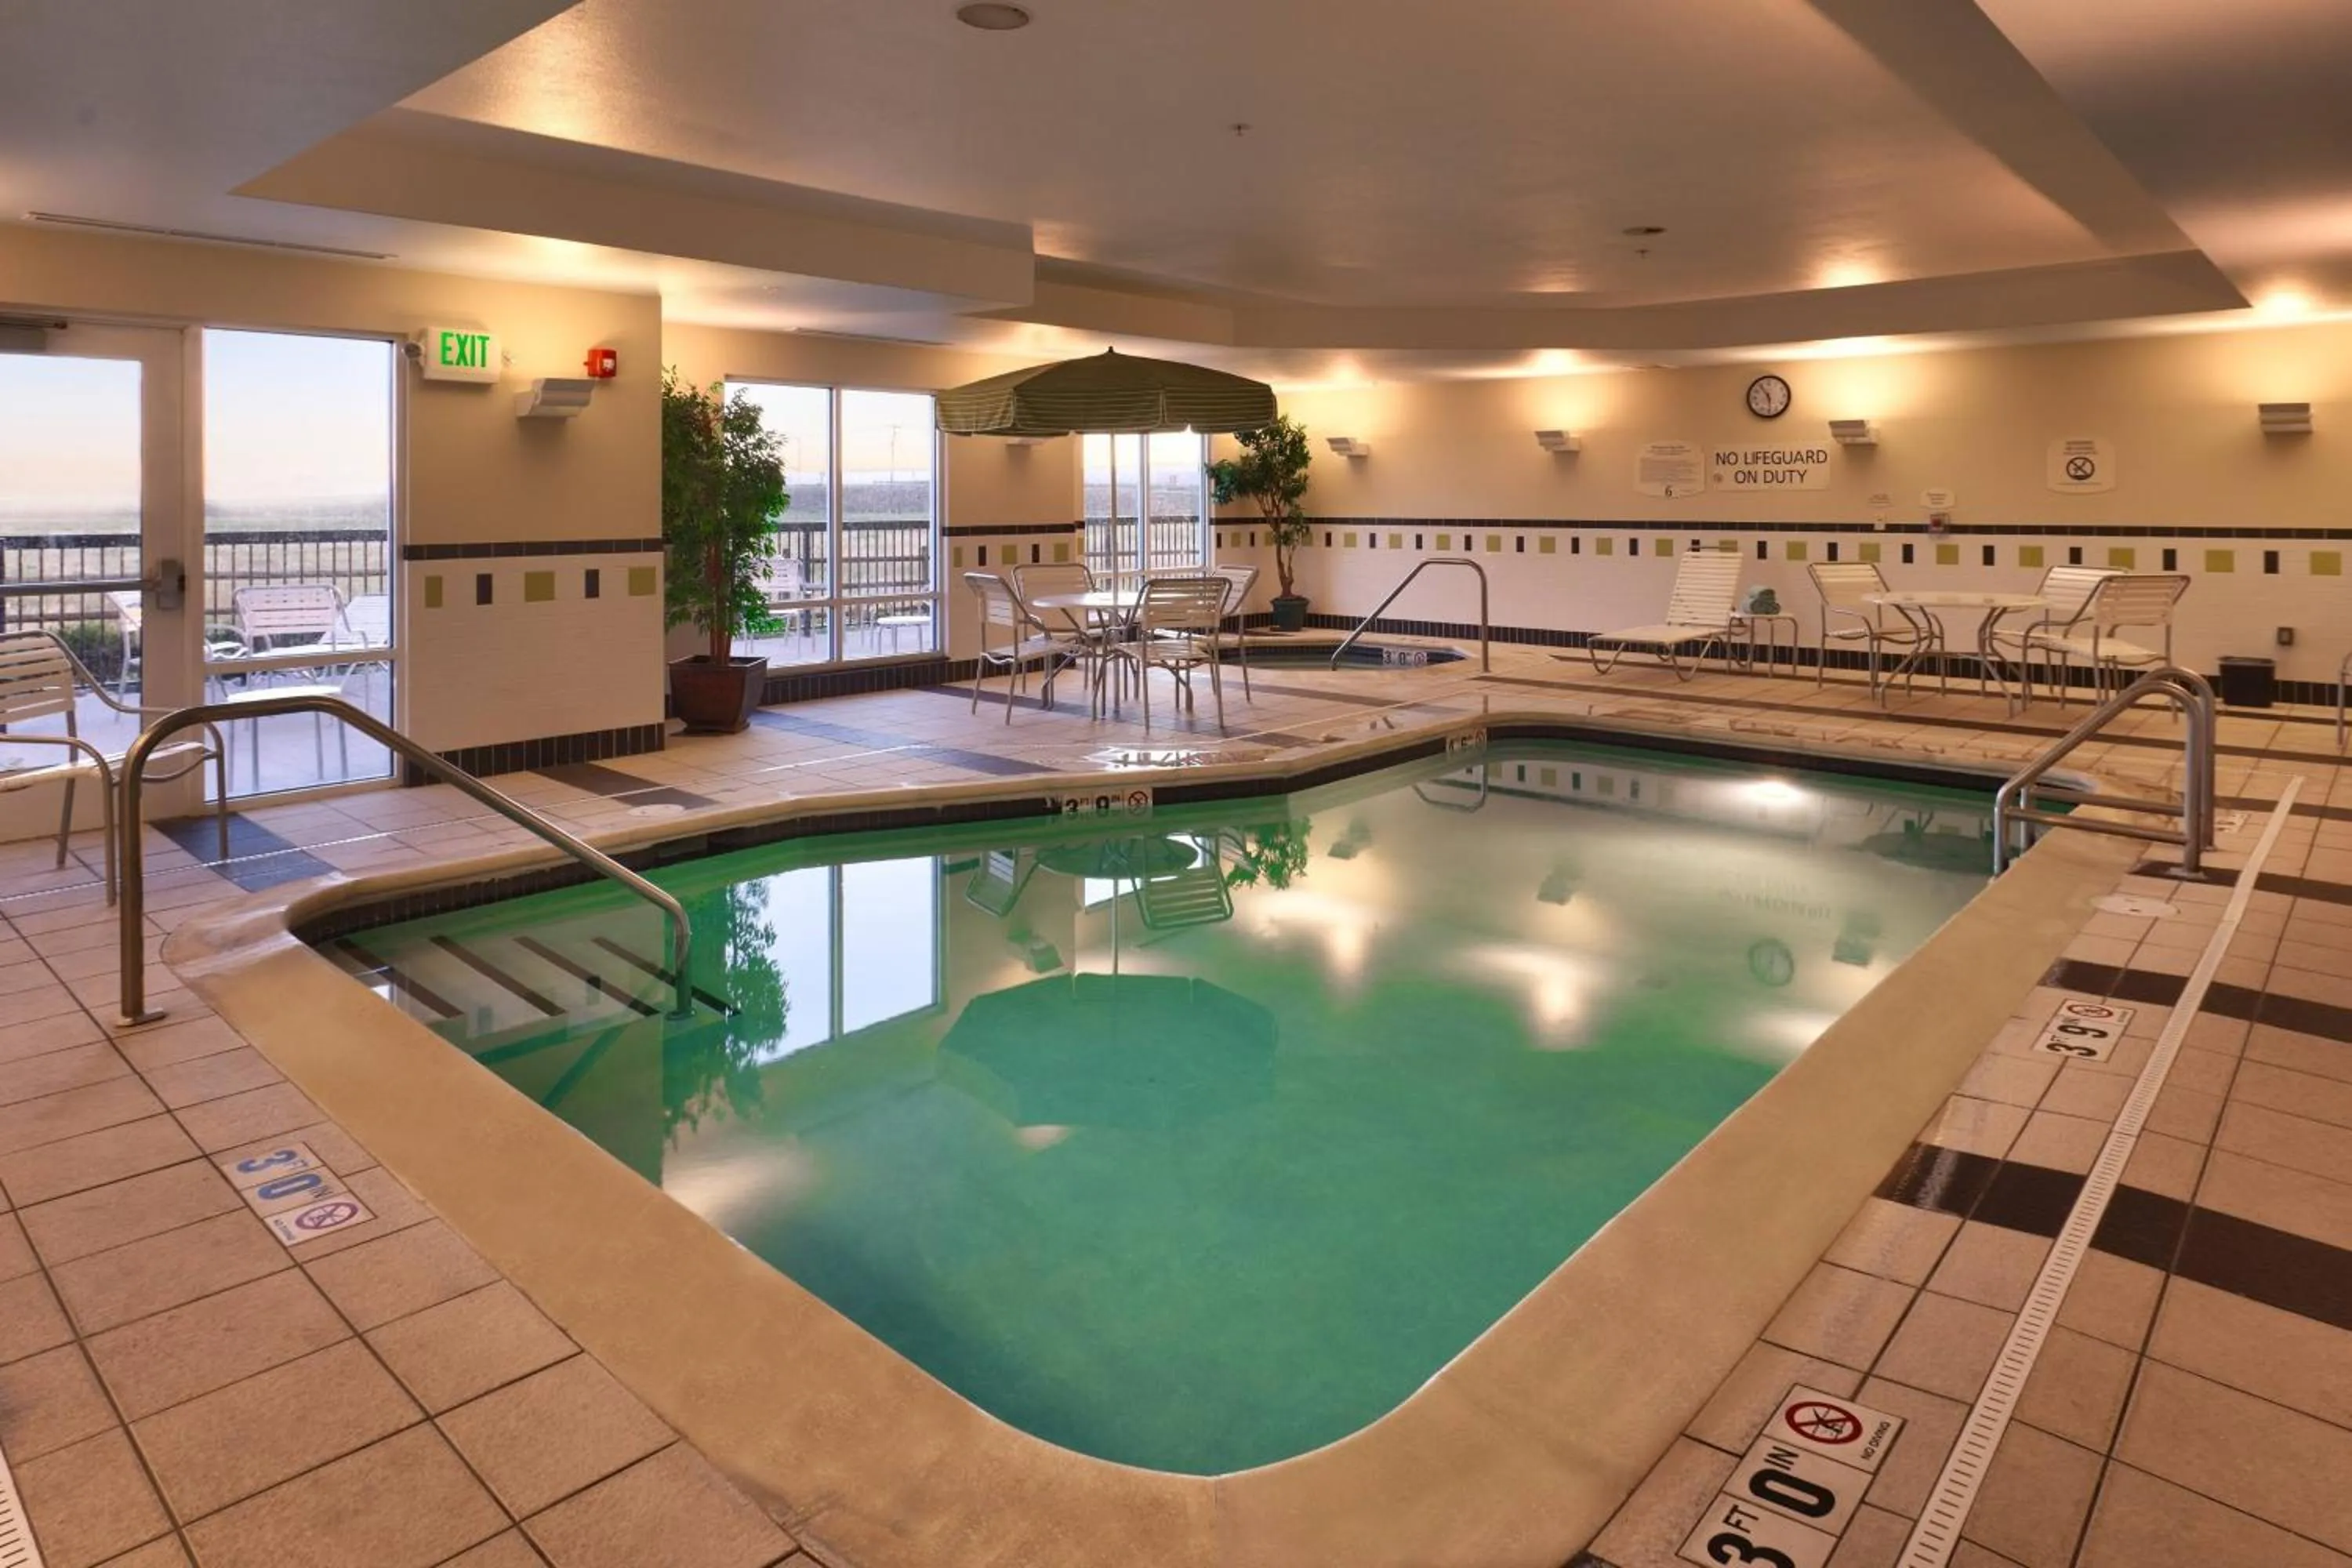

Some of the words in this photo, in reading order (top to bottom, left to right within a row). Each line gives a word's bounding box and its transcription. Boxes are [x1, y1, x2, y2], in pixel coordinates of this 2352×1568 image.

[440, 332, 490, 368] EXIT
[1715, 452, 1738, 466] NO
[1744, 449, 1828, 465] LIFEGUARD
[1734, 470, 1757, 484] ON
[1763, 470, 1807, 484] DUTY
[2057, 1025, 2108, 1038] 9
[2045, 1043, 2097, 1057] 3
[236, 1149, 297, 1173] 3
[257, 1174, 322, 1200] 0
[1764, 1446, 1799, 1471] IN
[1748, 1468, 1835, 1518] 0
[1722, 1504, 1759, 1534] FT
[1707, 1533, 1795, 1568] 3
